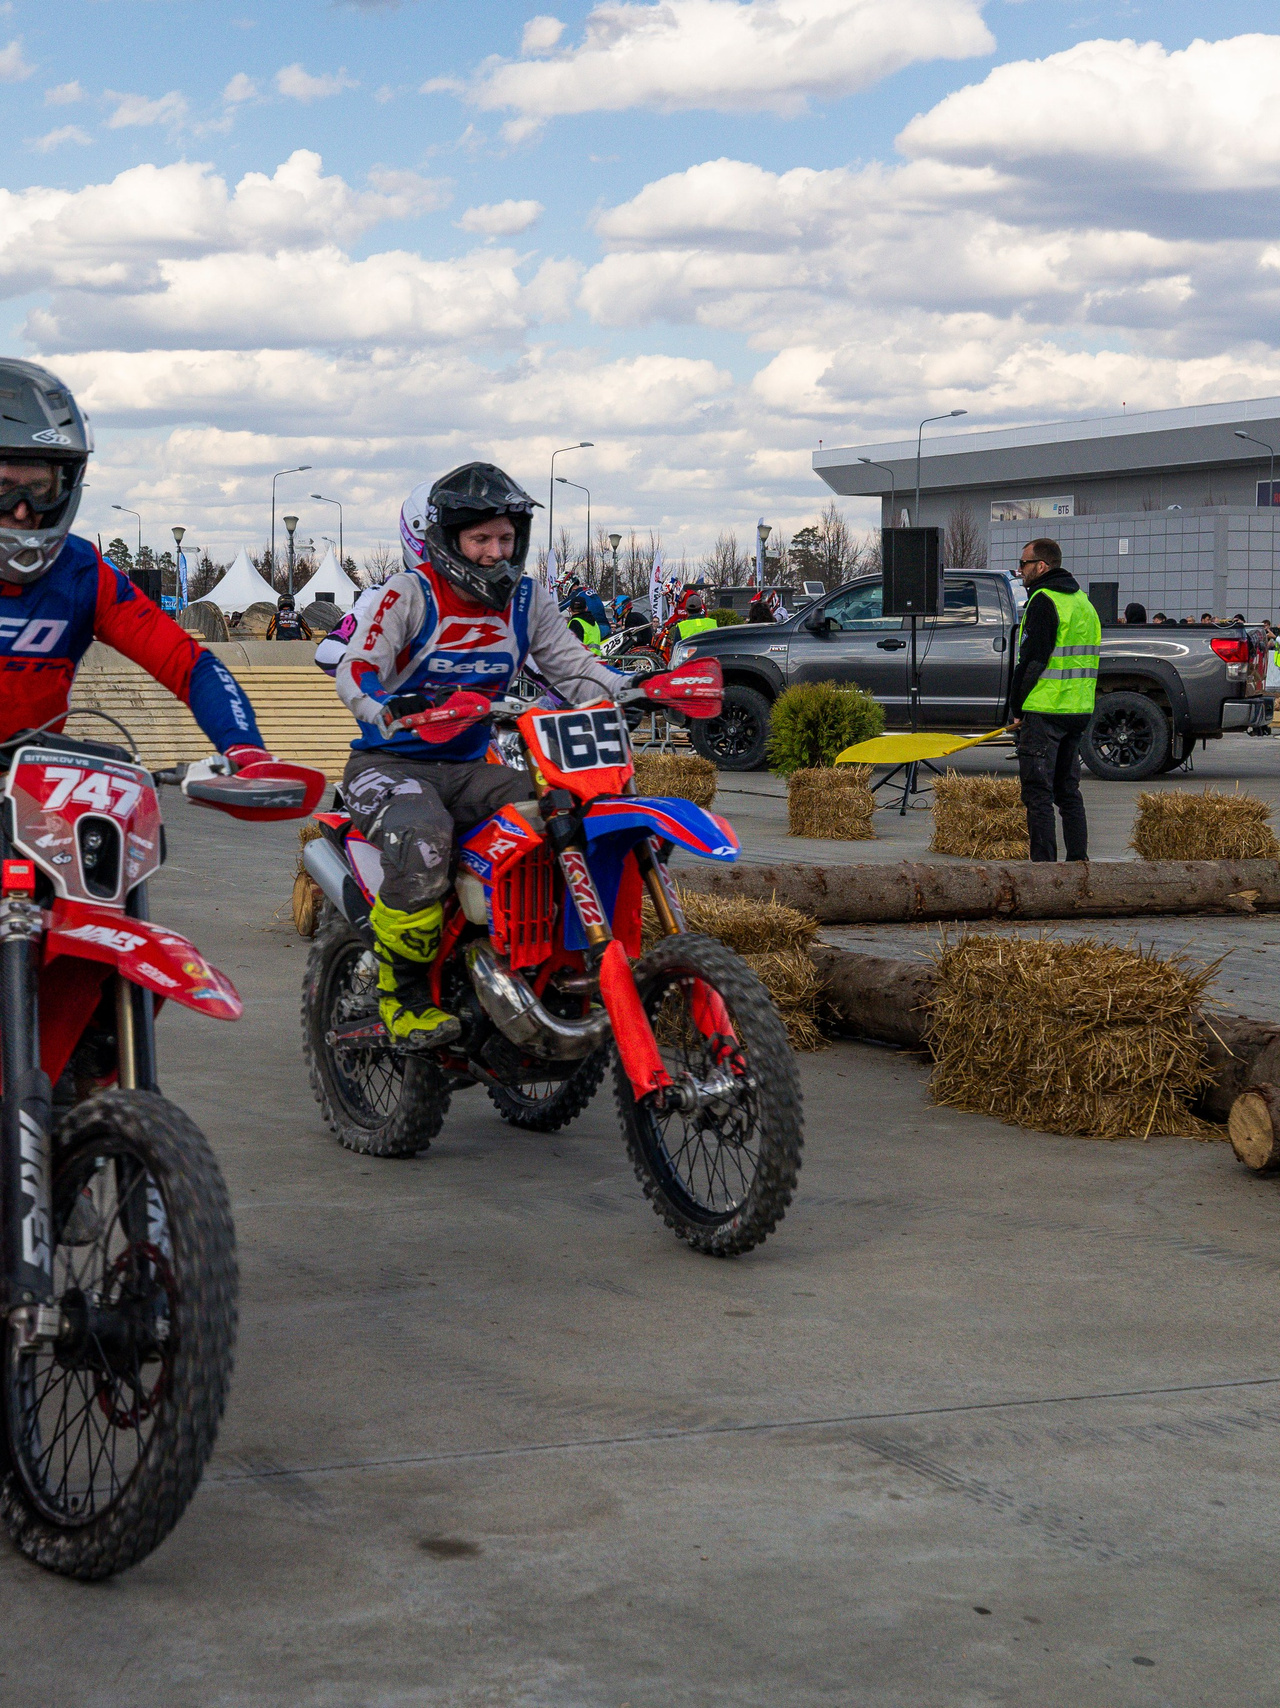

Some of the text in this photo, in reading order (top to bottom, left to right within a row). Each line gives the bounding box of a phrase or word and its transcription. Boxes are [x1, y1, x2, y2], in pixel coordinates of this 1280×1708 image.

[1057, 505, 1070, 515] ВТБ
[427, 658, 510, 675] Beta
[539, 710, 627, 770] 165
[24, 754, 90, 767] SITNIKOV VS
[40, 766, 144, 820] 747
[559, 851, 604, 927] KYB
